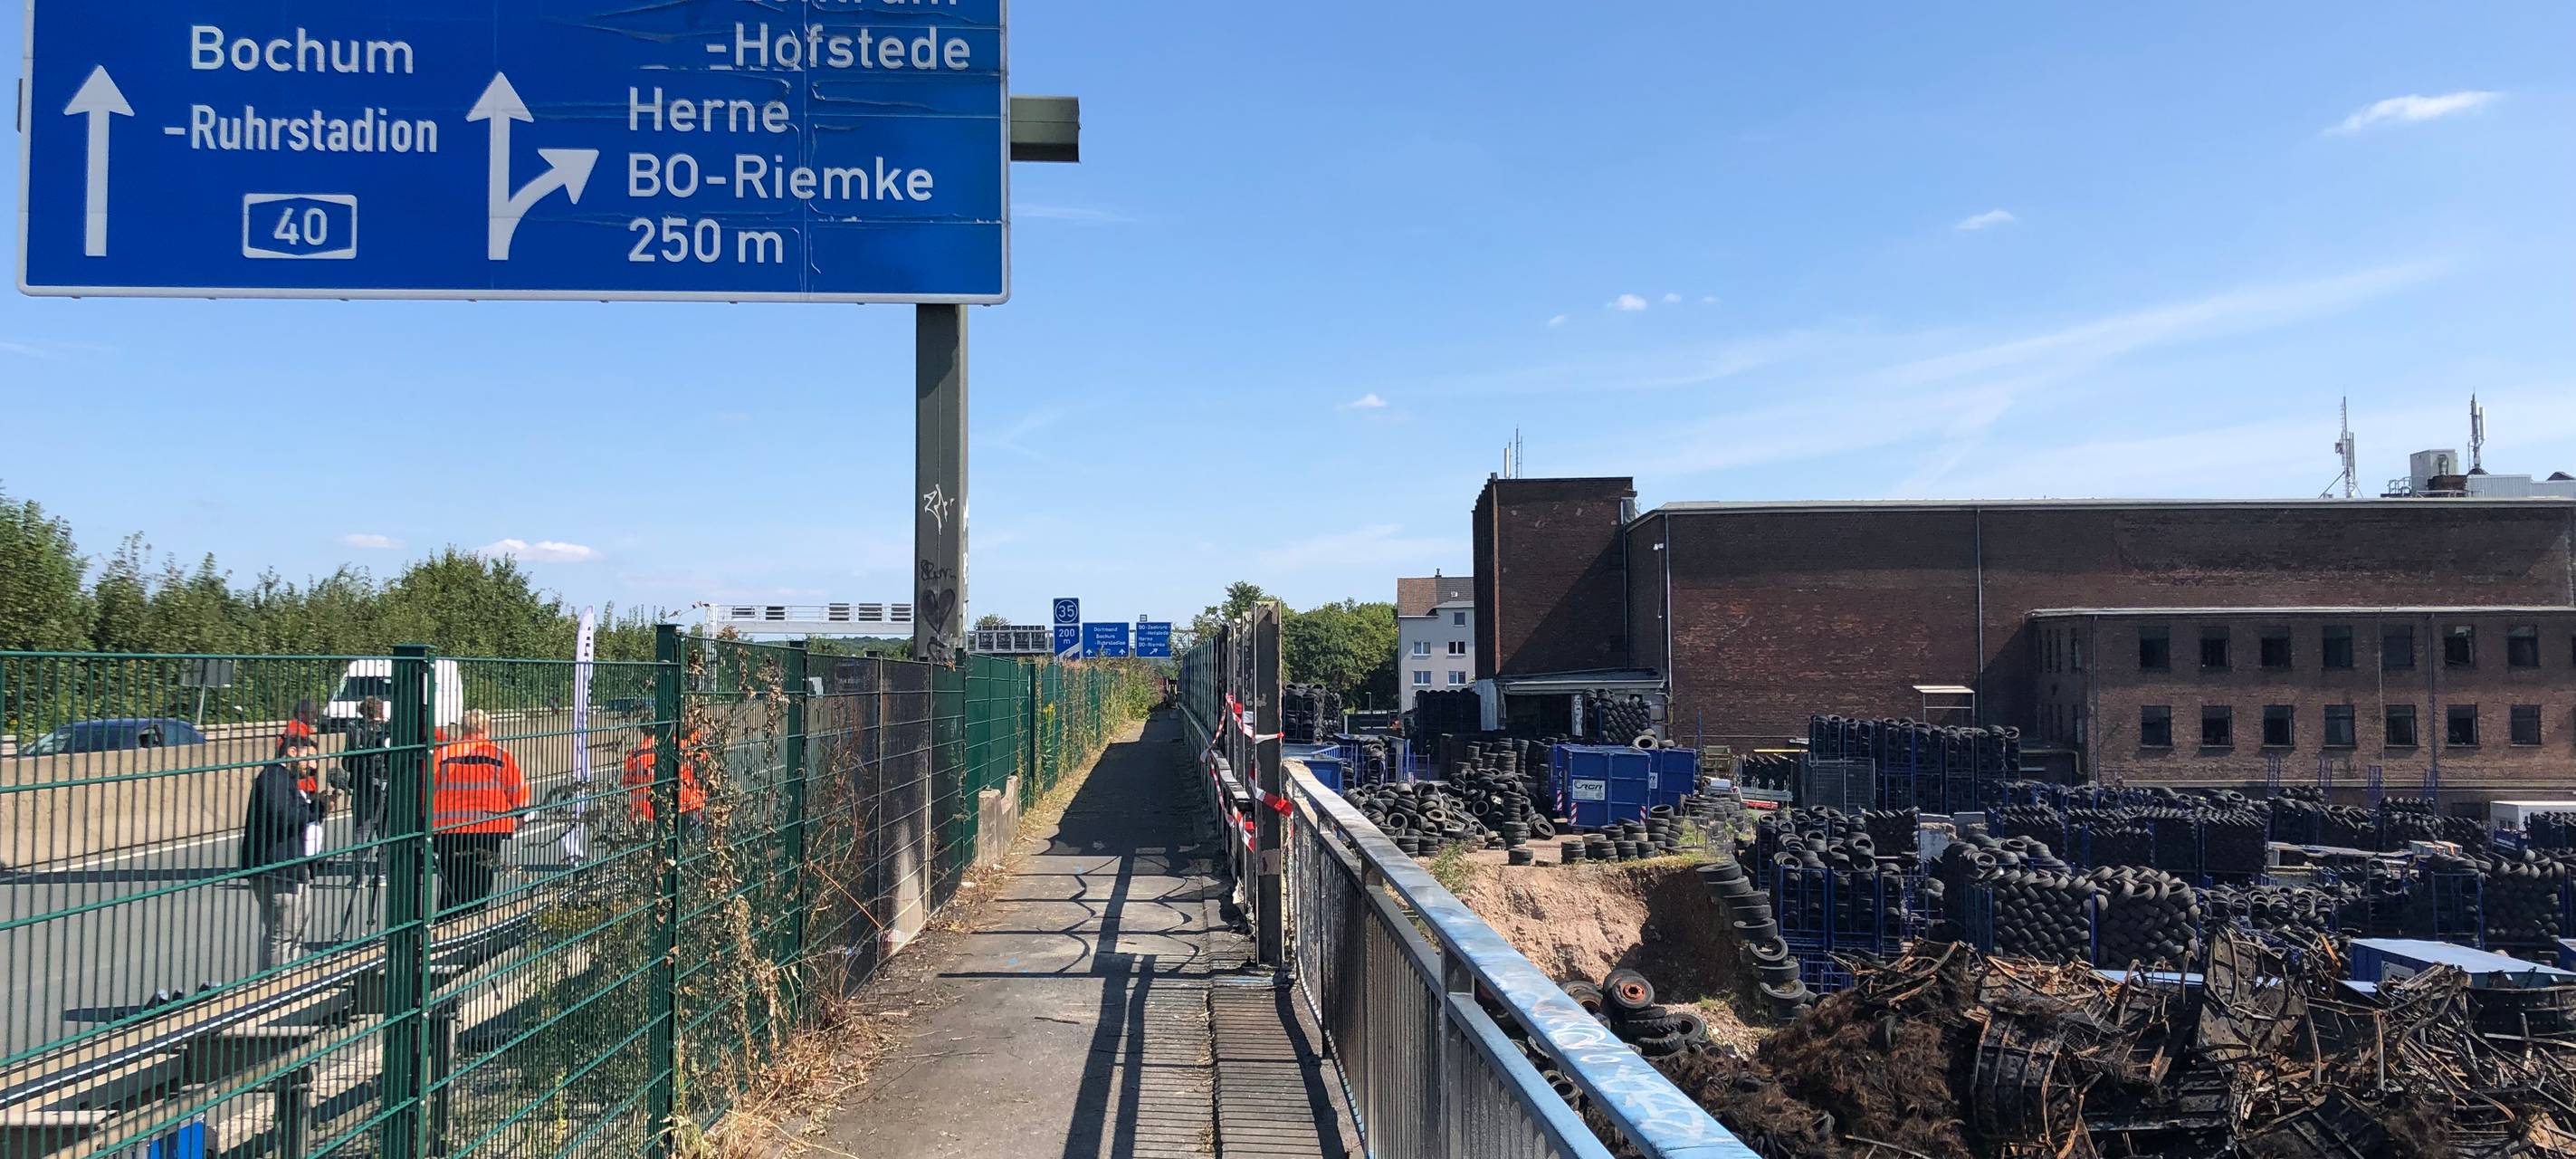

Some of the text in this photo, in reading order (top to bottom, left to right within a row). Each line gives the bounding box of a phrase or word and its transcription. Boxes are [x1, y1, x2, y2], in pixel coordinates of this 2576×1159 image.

[191, 25, 414, 73] Bochum
[706, 23, 970, 70] -Hofstede
[164, 105, 438, 153] -Ruhrstadion
[629, 86, 790, 133] Herne
[628, 153, 934, 201] BO-Riemke
[272, 209, 329, 247] 40
[628, 217, 784, 263] 250 m
[1058, 605, 1075, 618] 35
[1058, 628, 1075, 637] 200
